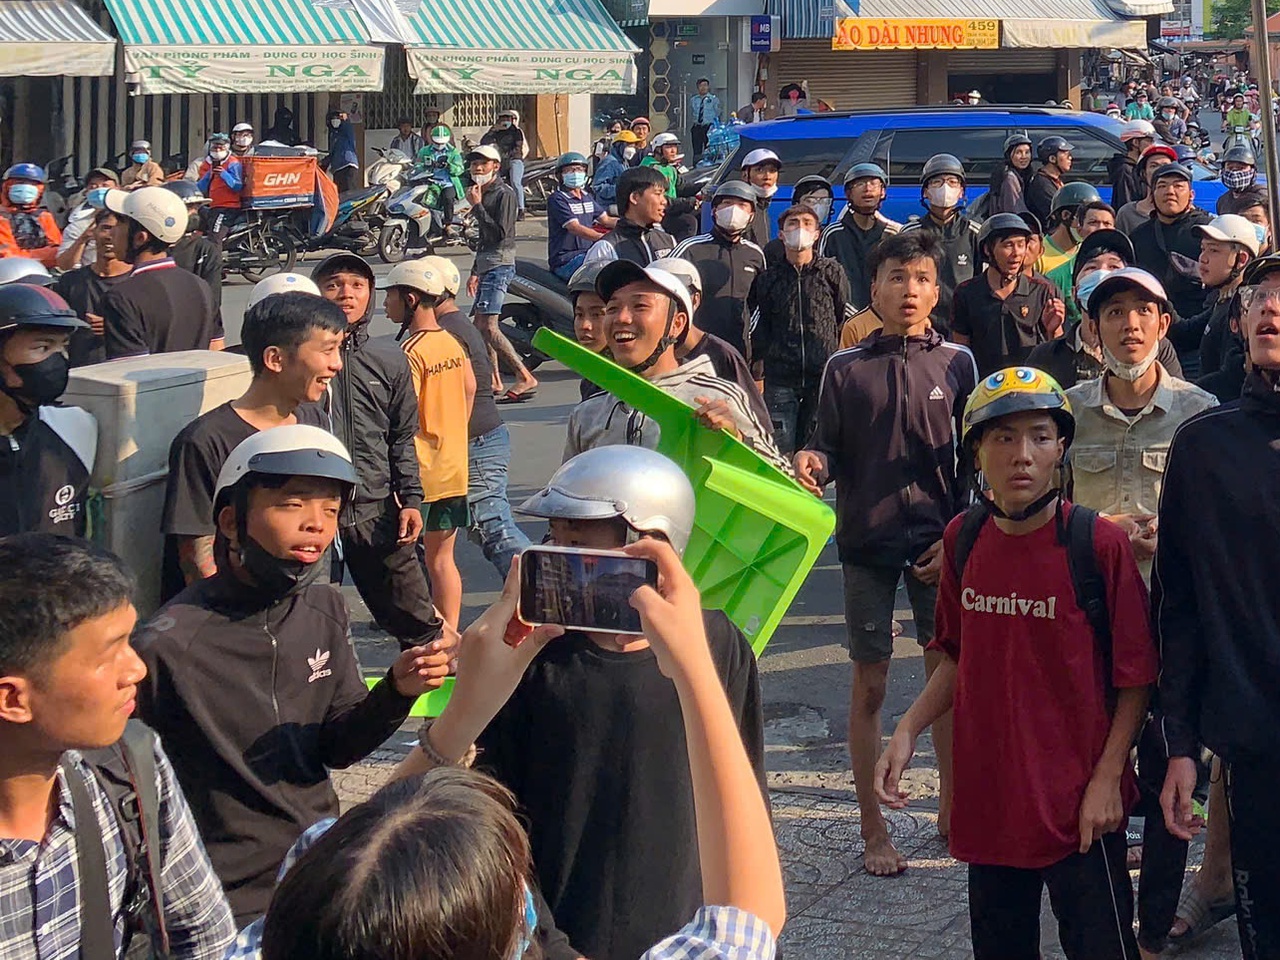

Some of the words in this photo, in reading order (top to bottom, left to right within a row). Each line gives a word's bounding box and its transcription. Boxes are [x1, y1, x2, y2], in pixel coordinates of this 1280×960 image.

[759, 23, 771, 33] MB
[836, 19, 861, 45] ÁO
[867, 20, 901, 45] DÀI
[905, 24, 964, 45] NHUNG
[968, 21, 996, 31] 459
[263, 51, 298, 59] DỤNG
[301, 51, 317, 60] CỤ
[322, 51, 346, 59] HỌC
[265, 64, 371, 78] NGA
[531, 68, 626, 81] NGA
[262, 172, 302, 187] GHN
[961, 587, 1057, 620] Carnival
